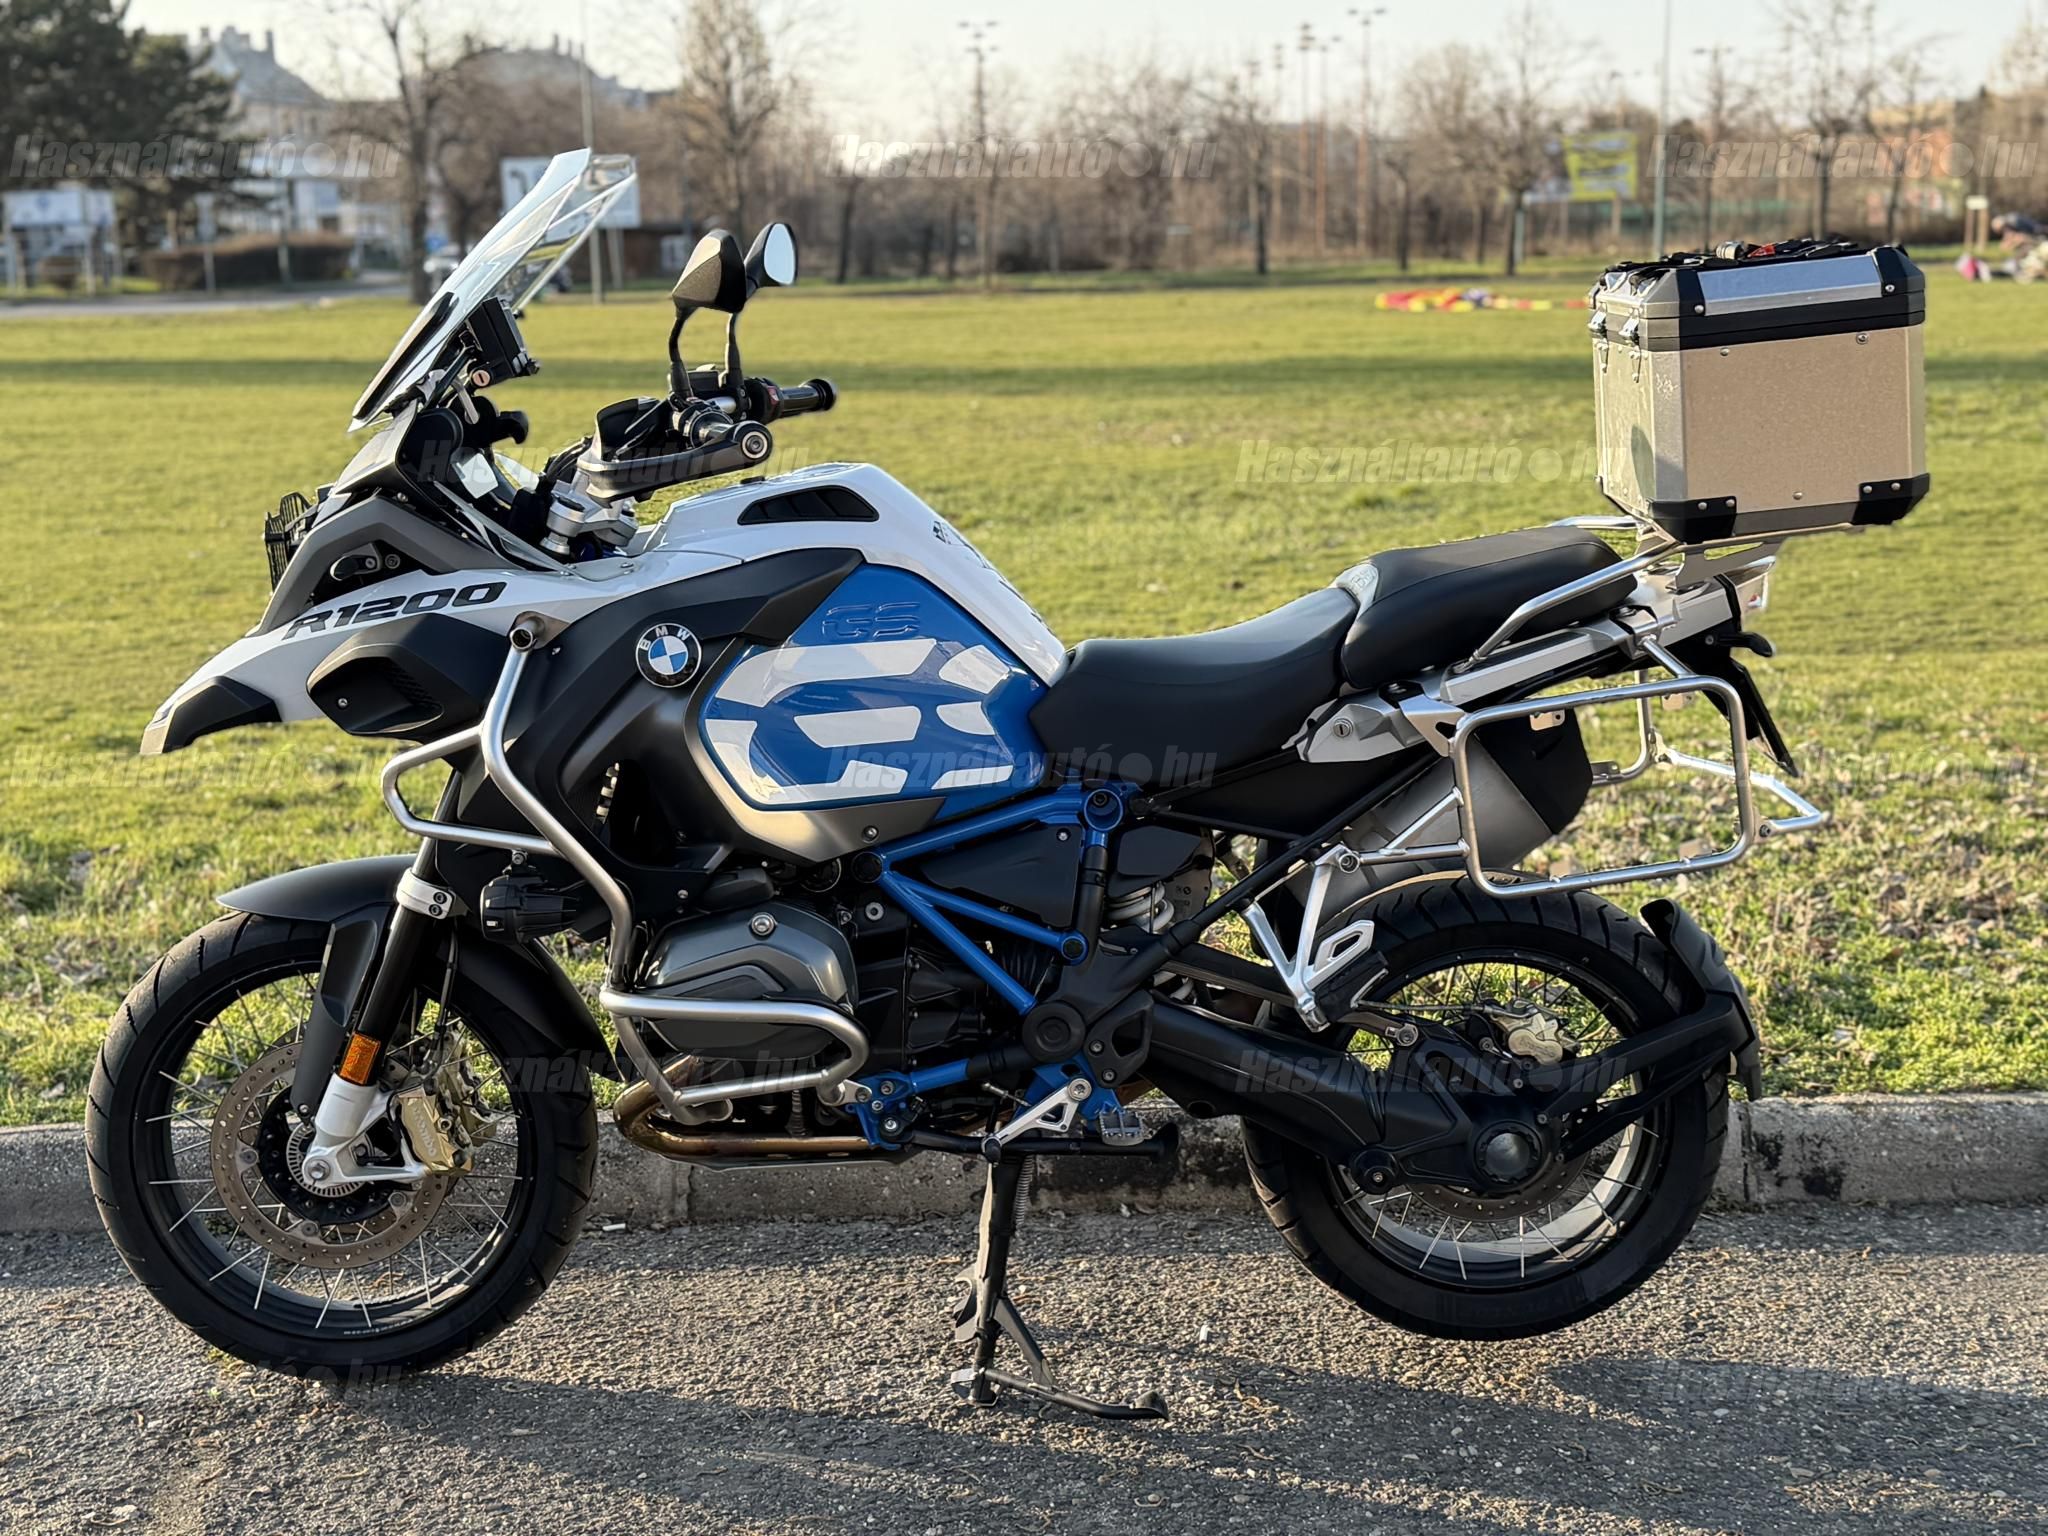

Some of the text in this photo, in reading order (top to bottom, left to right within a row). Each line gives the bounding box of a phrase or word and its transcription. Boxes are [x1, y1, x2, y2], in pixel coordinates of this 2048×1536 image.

[282, 582, 507, 640] R1200
[822, 602, 920, 638] GS
[639, 625, 691, 651] BMW
